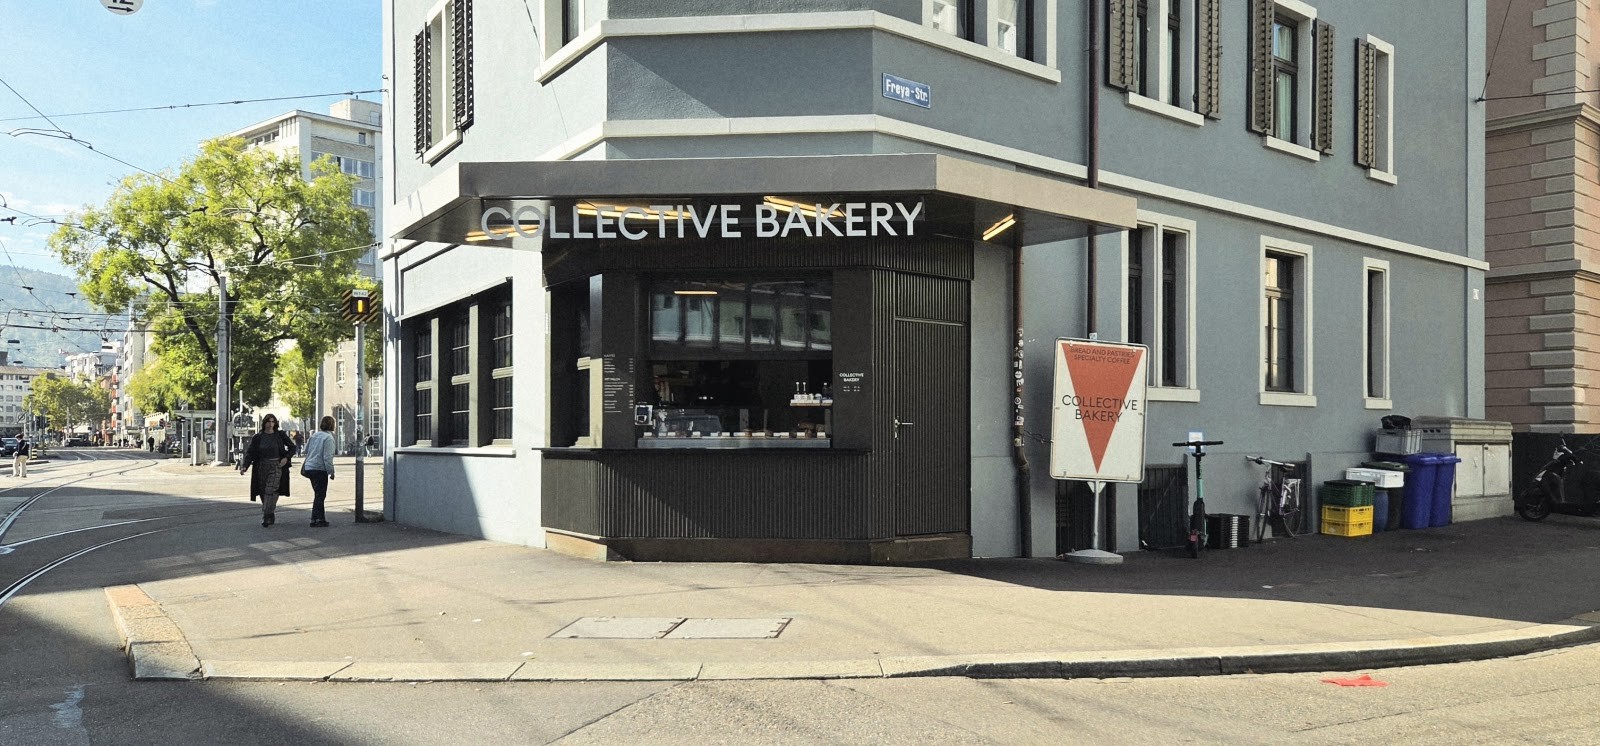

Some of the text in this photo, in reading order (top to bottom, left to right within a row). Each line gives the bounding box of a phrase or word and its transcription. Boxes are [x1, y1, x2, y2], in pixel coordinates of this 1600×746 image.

[480, 202, 923, 241] COLLECTIVE BAKERY
[1070, 347, 1092, 355] BREAD
[1107, 350, 1135, 358] PASTRIES
[1074, 354, 1131, 365] SPECIALTY COFFEE
[1062, 394, 1138, 411] COLLECTIVE
[1075, 408, 1123, 422] BAKERY
